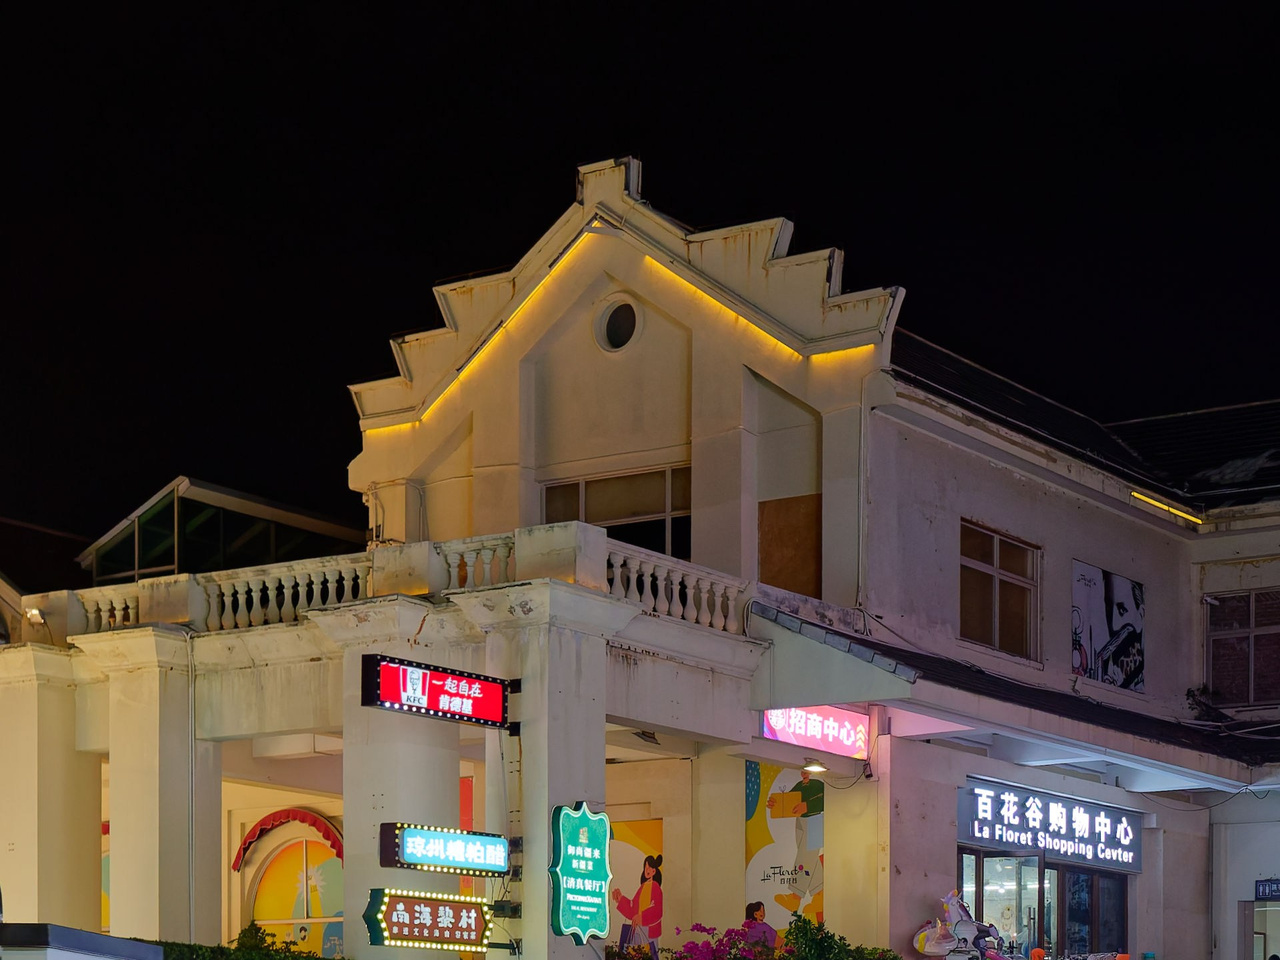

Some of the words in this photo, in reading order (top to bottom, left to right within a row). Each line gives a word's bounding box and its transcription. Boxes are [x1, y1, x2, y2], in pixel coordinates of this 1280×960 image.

[406, 695, 424, 705] KFC
[432, 677, 483, 697] 一起自在
[439, 695, 473, 714] 肯德基
[790, 708, 855, 745] 招商中心
[974, 788, 1133, 845] 百花谷购物中心
[974, 821, 989, 838] La
[995, 825, 1032, 846] Floret
[1037, 832, 1093, 859] Shopping
